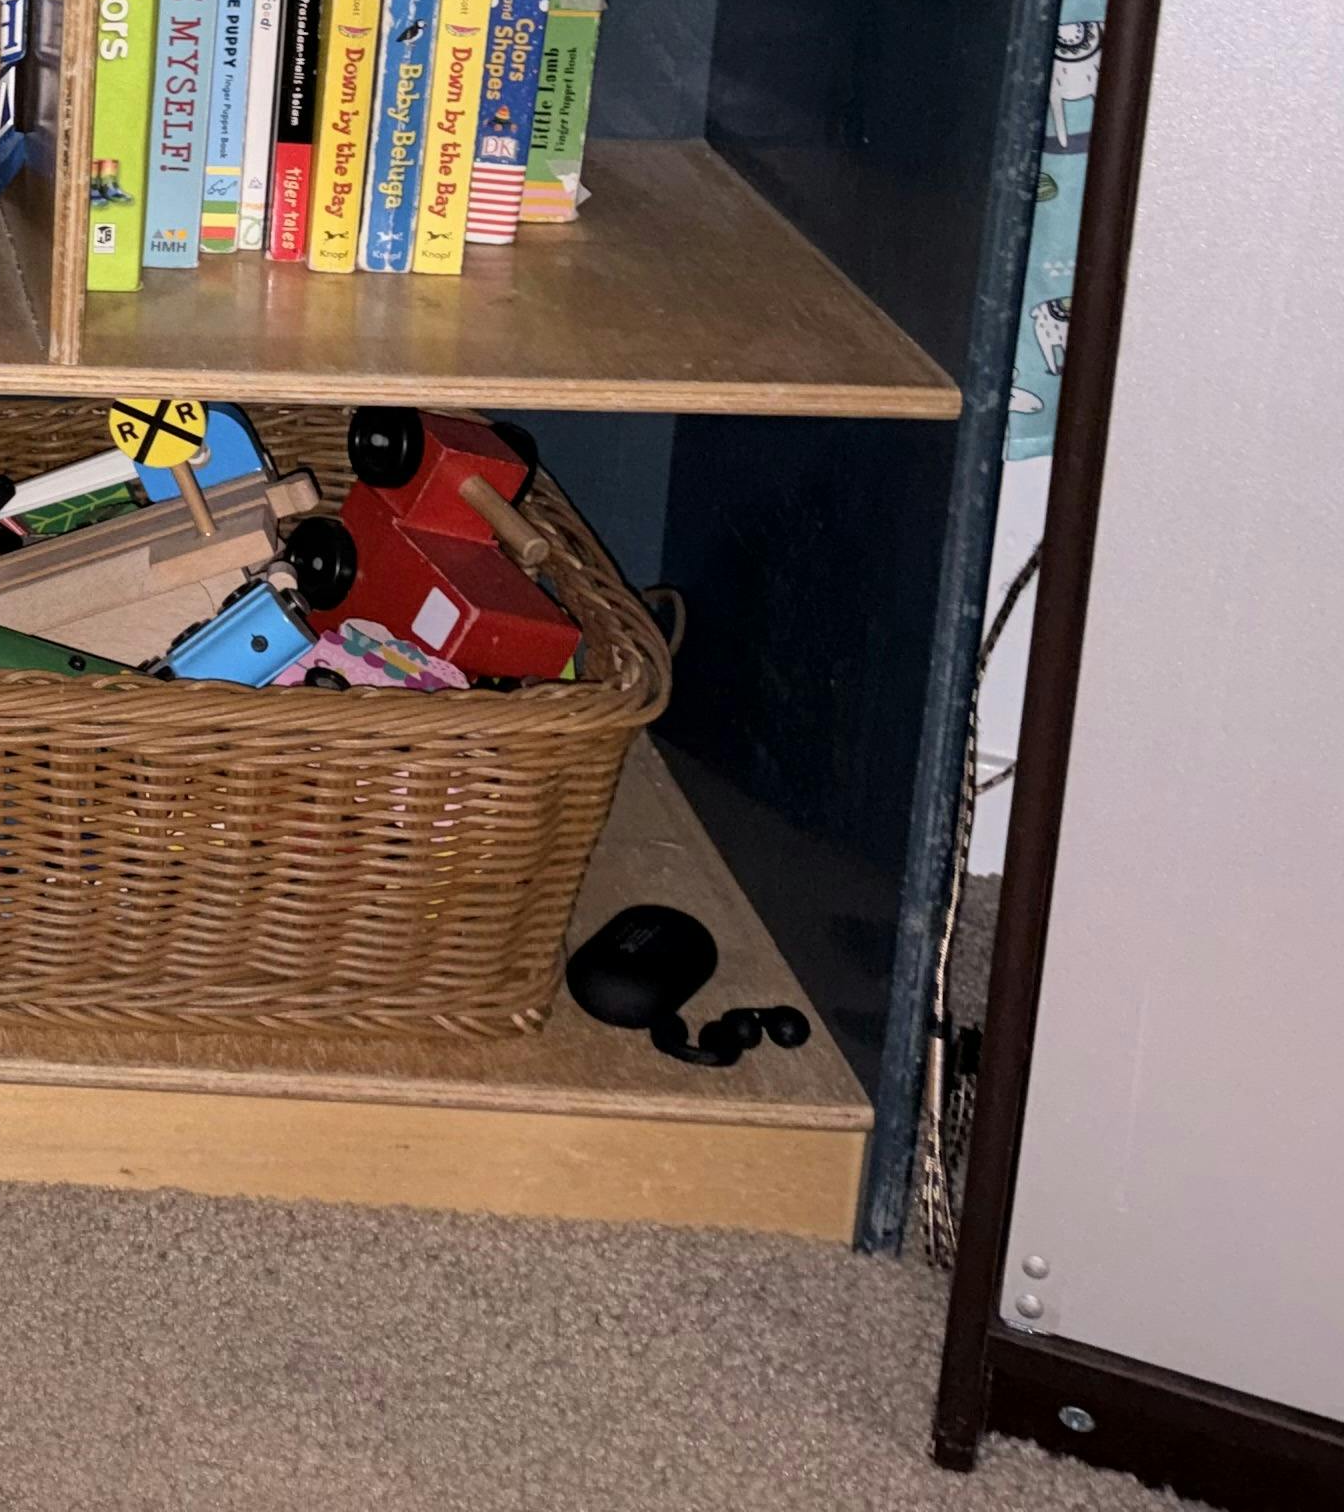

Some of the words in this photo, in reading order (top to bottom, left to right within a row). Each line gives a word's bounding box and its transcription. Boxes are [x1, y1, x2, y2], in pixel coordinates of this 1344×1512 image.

[223, 14, 240, 68] PUPPY
[509, 18, 536, 82] Colors
[342, 48, 365, 104] Down
[448, 47, 472, 103] Down
[486, 25, 514, 100] Shapes
[538, 47, 560, 93] Lamb
[563, 47, 578, 75] Book
[160, 15, 202, 173] MYSELF!
[222, 75, 234, 102] Finger
[387, 63, 423, 123] Baby
[558, 78, 576, 115] Puppet
[220, 104, 232, 135] Puppet
[289, 93, 303, 126] Bolam
[332, 109, 359, 135] by
[437, 110, 466, 136] by
[531, 100, 553, 150] Little
[219, 138, 230, 159] Book
[483, 138, 516, 156] DK
[554, 118, 569, 152] Finger
[335, 142, 356, 176] the
[378, 131, 416, 209] Beluga
[440, 142, 462, 176] the
[284, 167, 302, 206] tiger
[325, 183, 353, 218] Bay
[428, 183, 457, 218] Bay
[150, 240, 187, 253] HMH
[281, 213, 300, 249] tales
[320, 249, 349, 260] Knopf
[421, 250, 452, 260] Knopf
[175, 402, 198, 424] R
[116, 421, 139, 443] R
